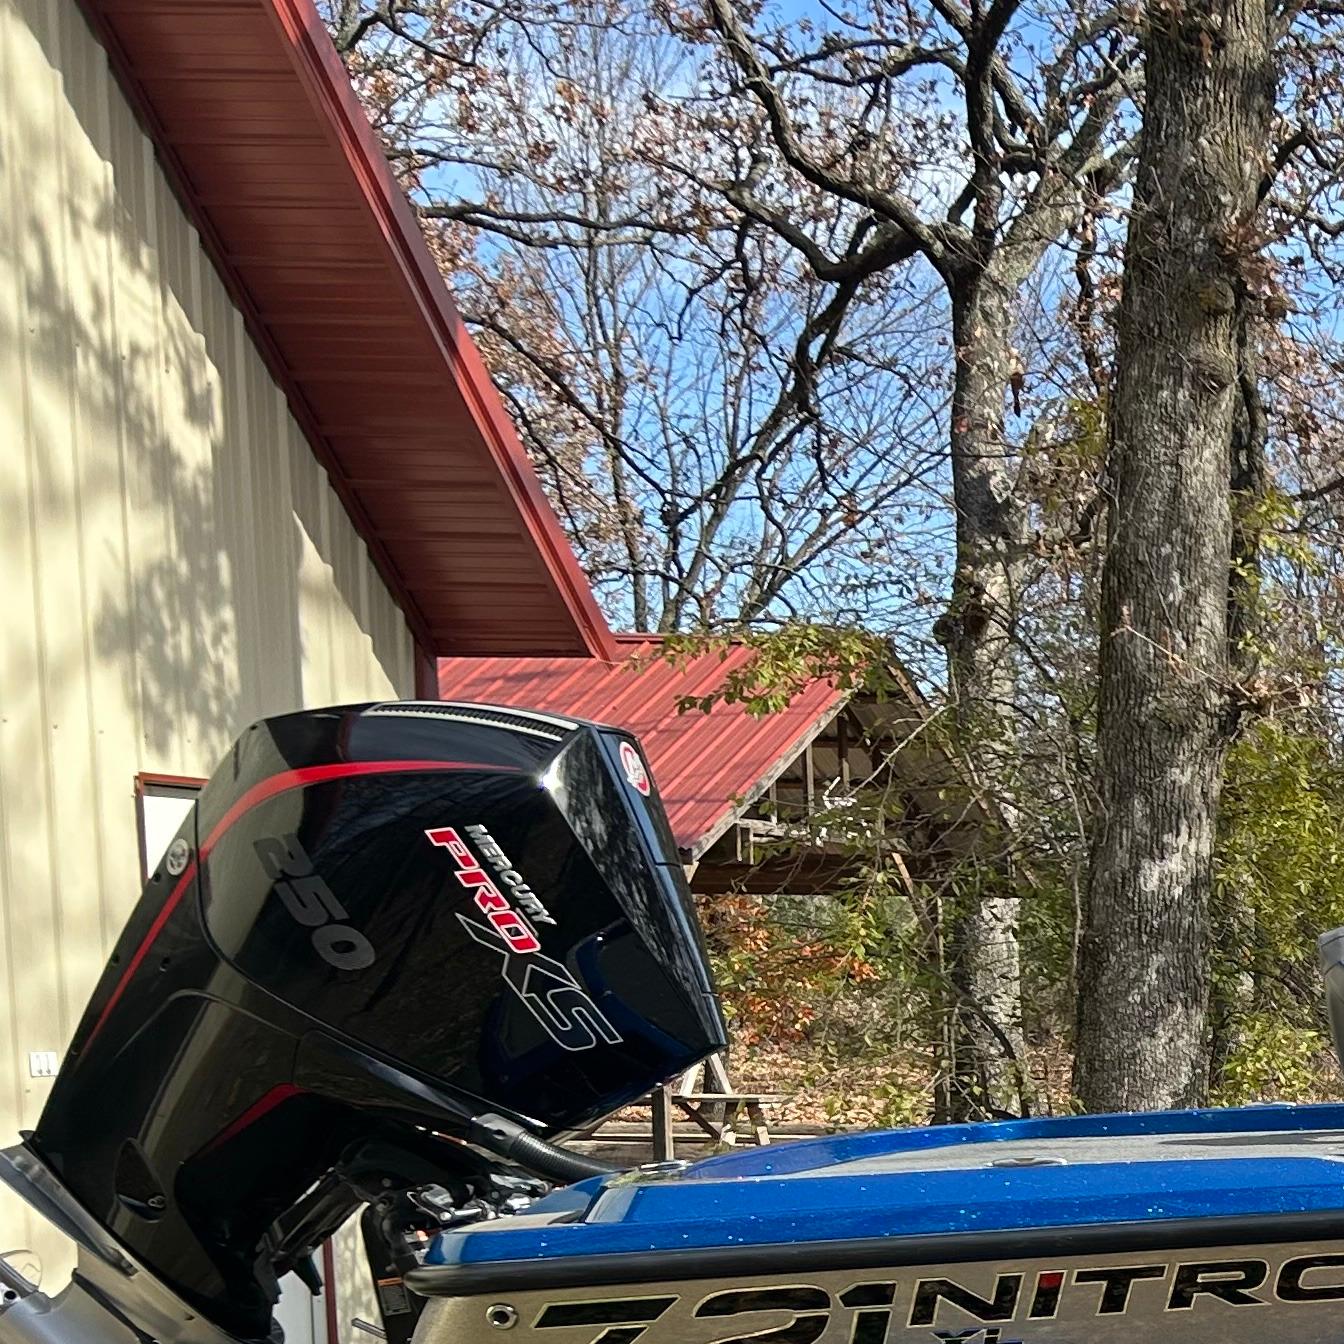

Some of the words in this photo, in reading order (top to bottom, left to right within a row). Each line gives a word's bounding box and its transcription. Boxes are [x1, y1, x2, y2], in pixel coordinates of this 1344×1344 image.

[253, 832, 375, 971] 250
[424, 827, 541, 954] PRO
[464, 823, 557, 925] MERCURY
[455, 907, 624, 1051] XS
